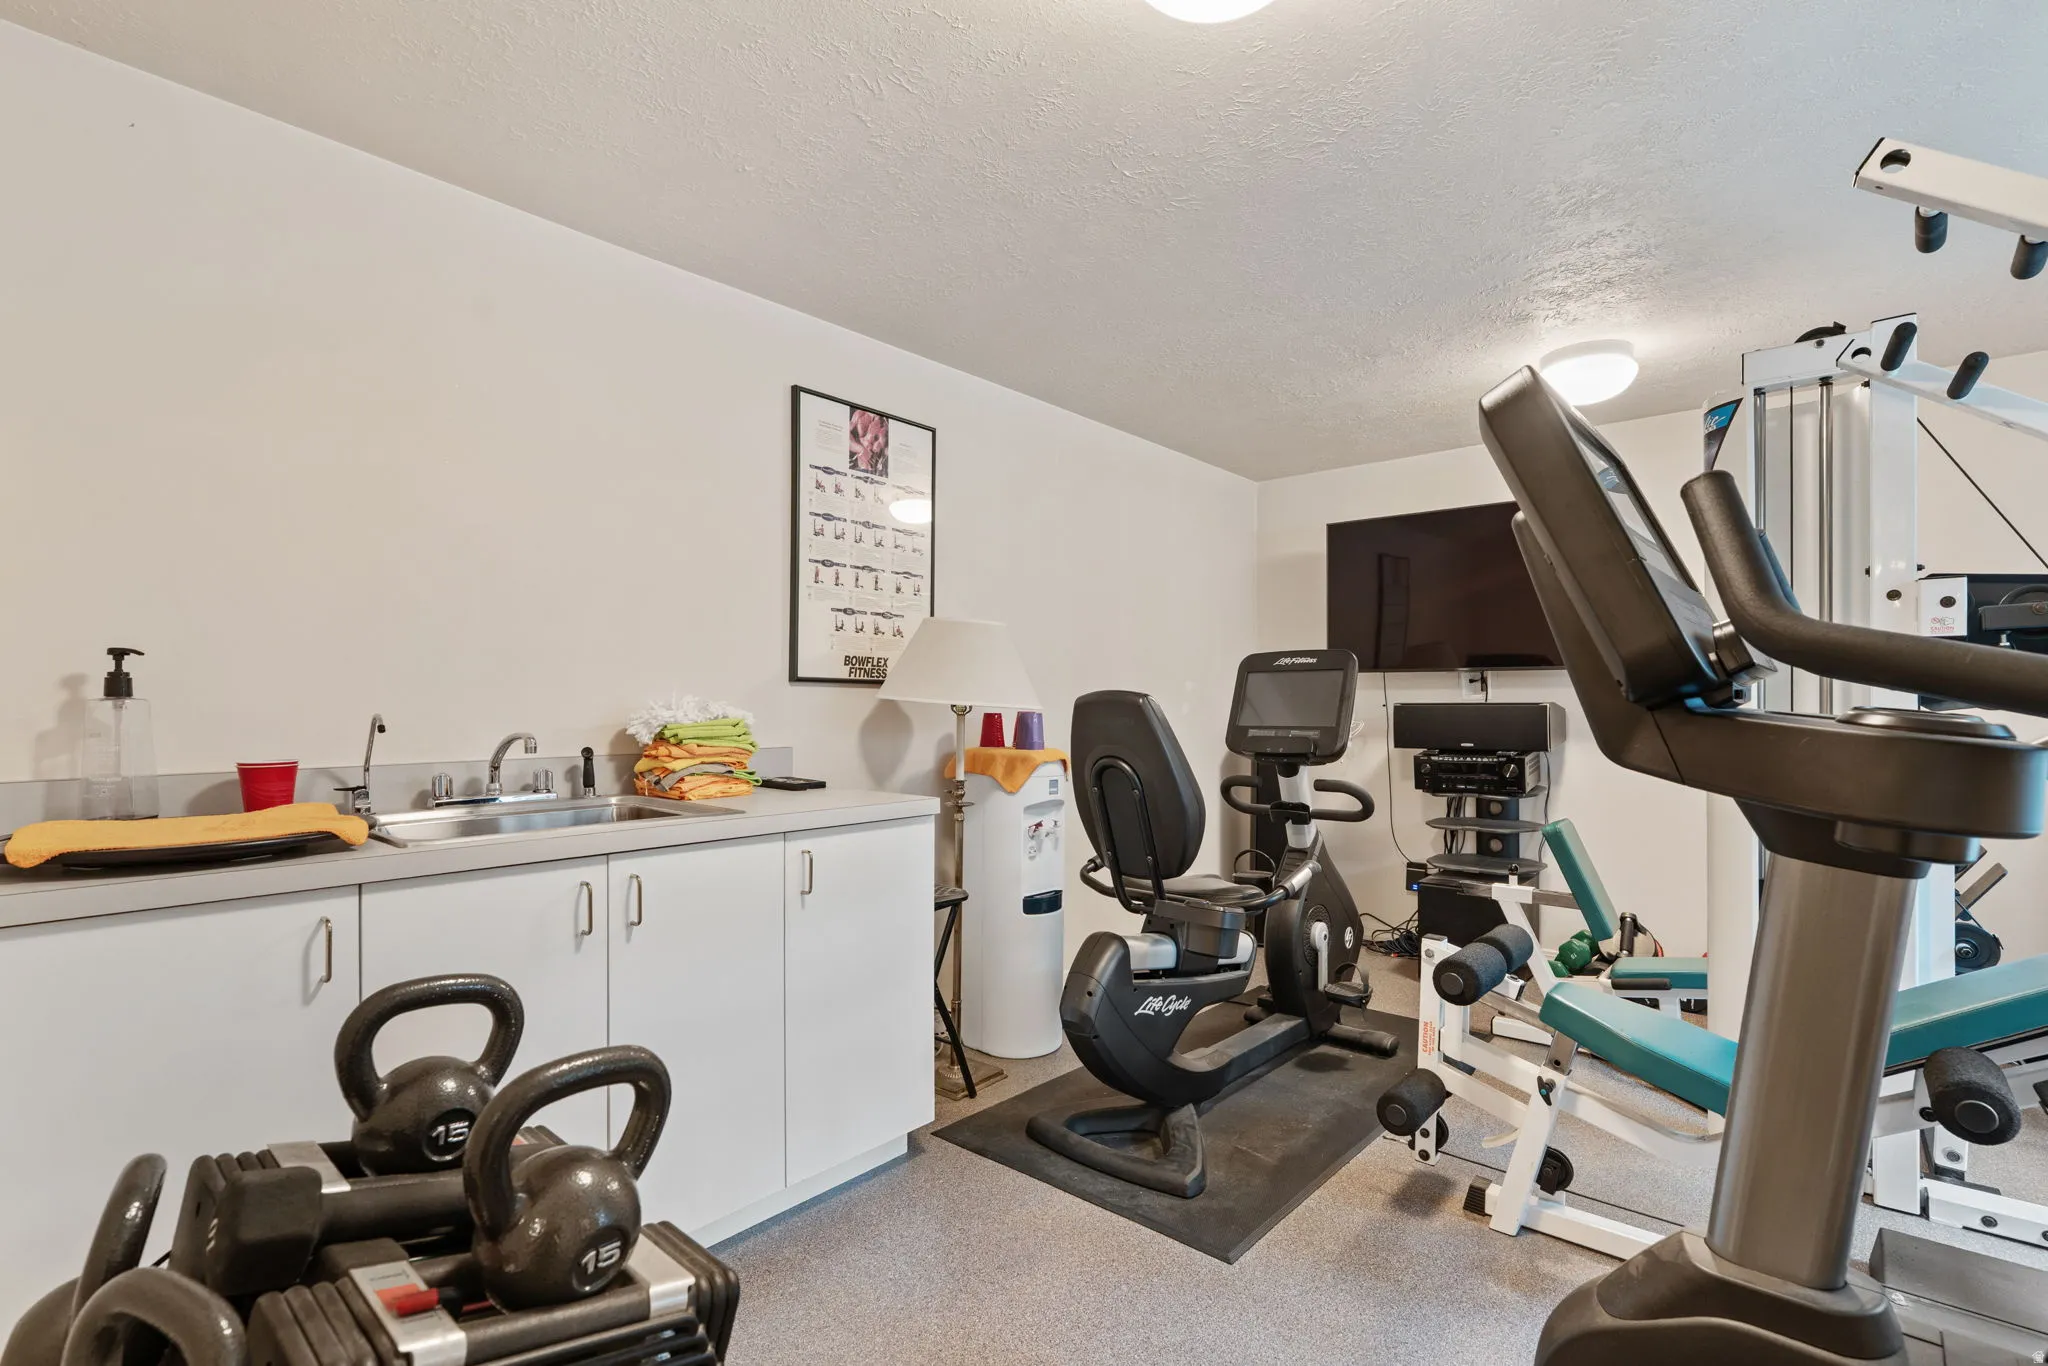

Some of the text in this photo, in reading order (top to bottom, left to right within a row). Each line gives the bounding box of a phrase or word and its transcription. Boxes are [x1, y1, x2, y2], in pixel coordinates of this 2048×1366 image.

[844, 655, 889, 668] BOWFLEX
[848, 667, 887, 678] FITNESS
[432, 1121, 469, 1145] 15
[581, 1240, 621, 1274] 15
